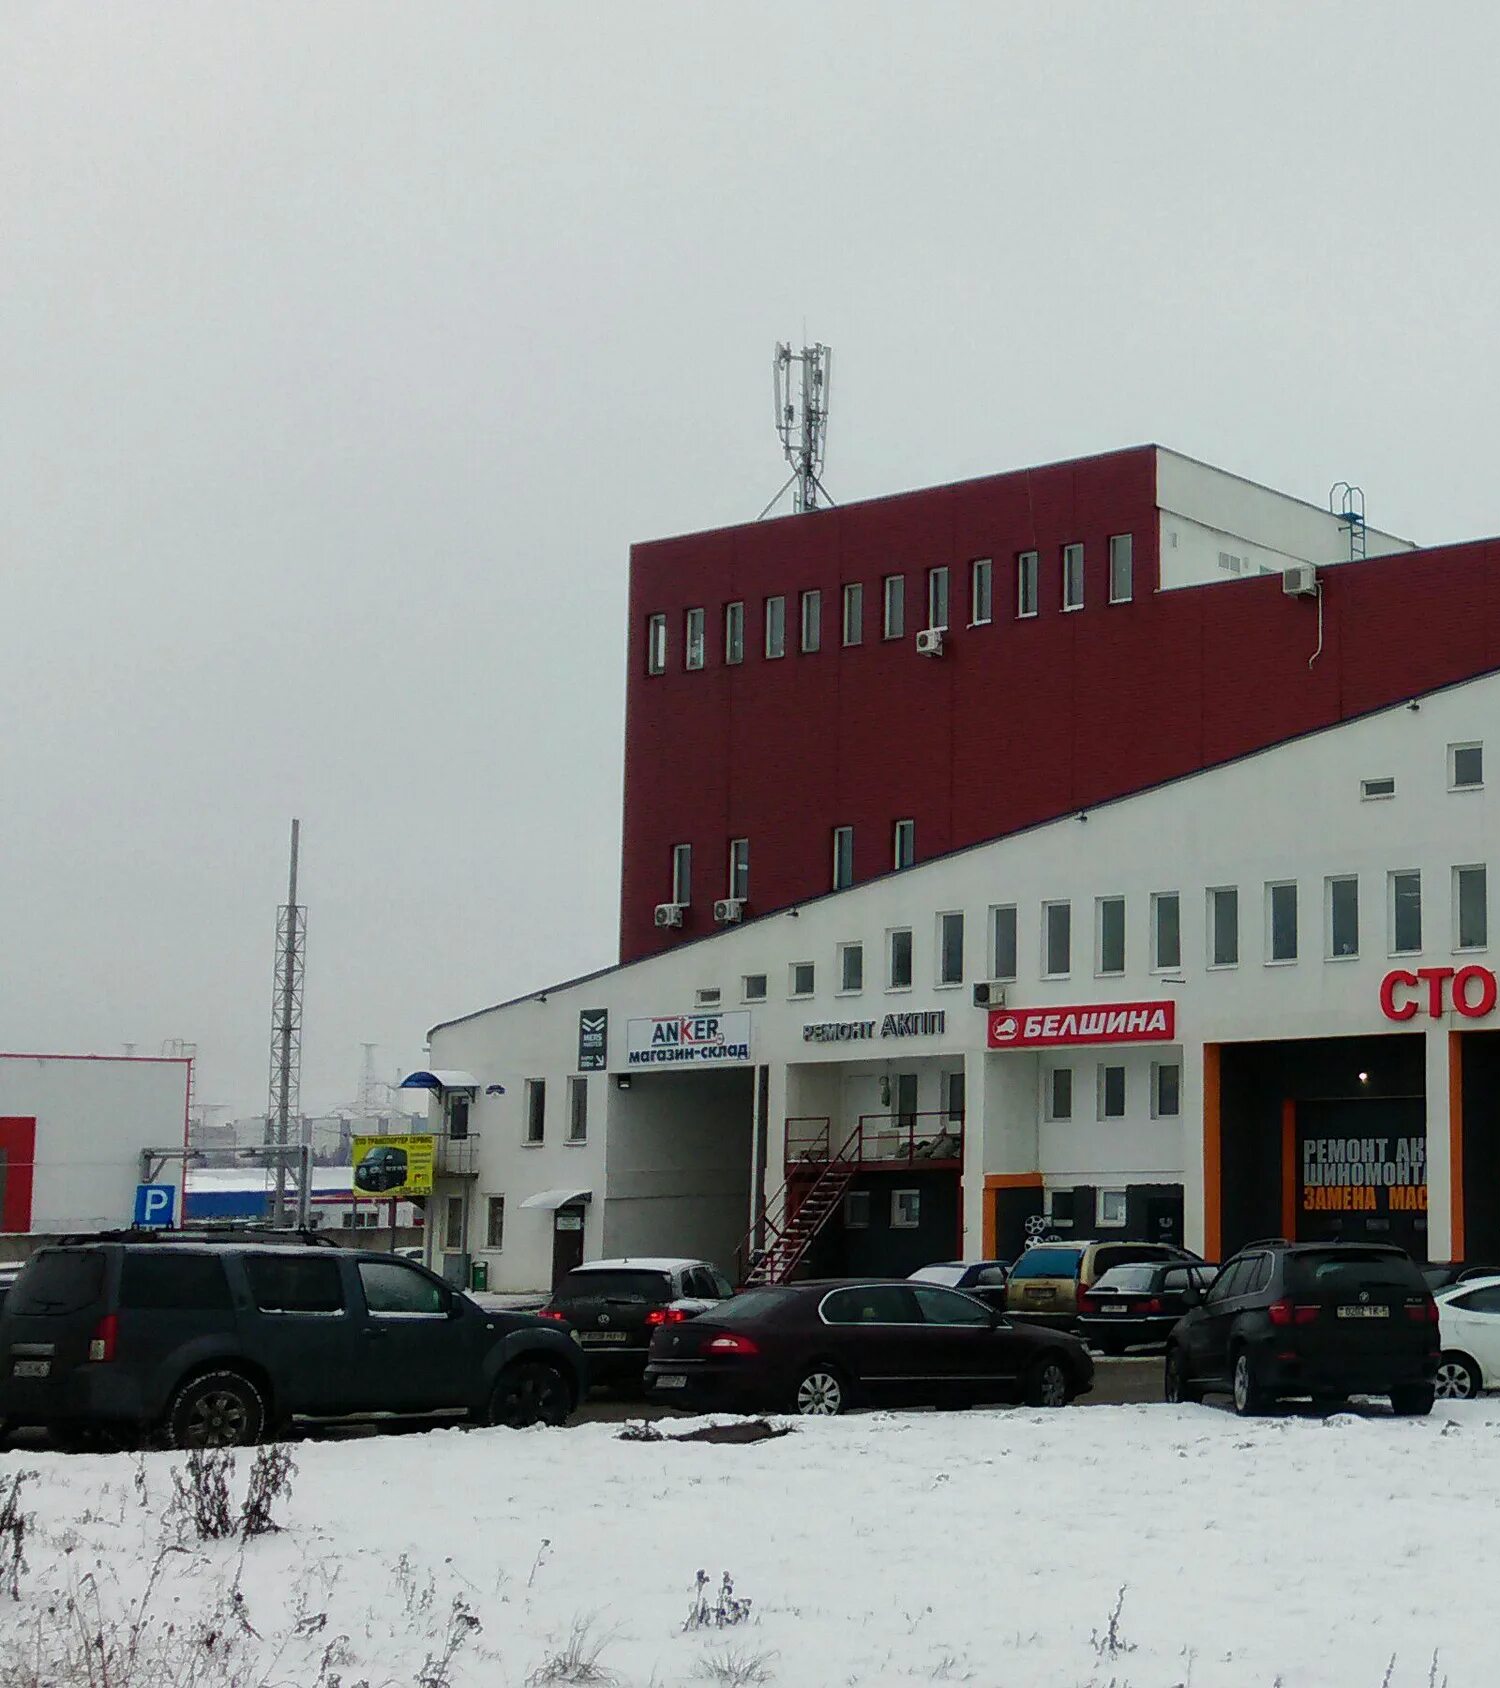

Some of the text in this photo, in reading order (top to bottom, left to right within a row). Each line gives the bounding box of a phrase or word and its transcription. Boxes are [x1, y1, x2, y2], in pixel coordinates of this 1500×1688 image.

[1380, 965, 1497, 1021] СТО
[652, 1018, 719, 1045] ANKER
[803, 1010, 945, 1042] РЕМОНТ АКПП
[1024, 1009, 1166, 1039] БЕЛШИНА
[629, 1044, 749, 1064] магазин-склад
[1303, 1139, 1388, 1163] РЕМОНТ
[145, 1190, 168, 1220] P
[1304, 1186, 1428, 1210] ЗАМЕНА МАС
